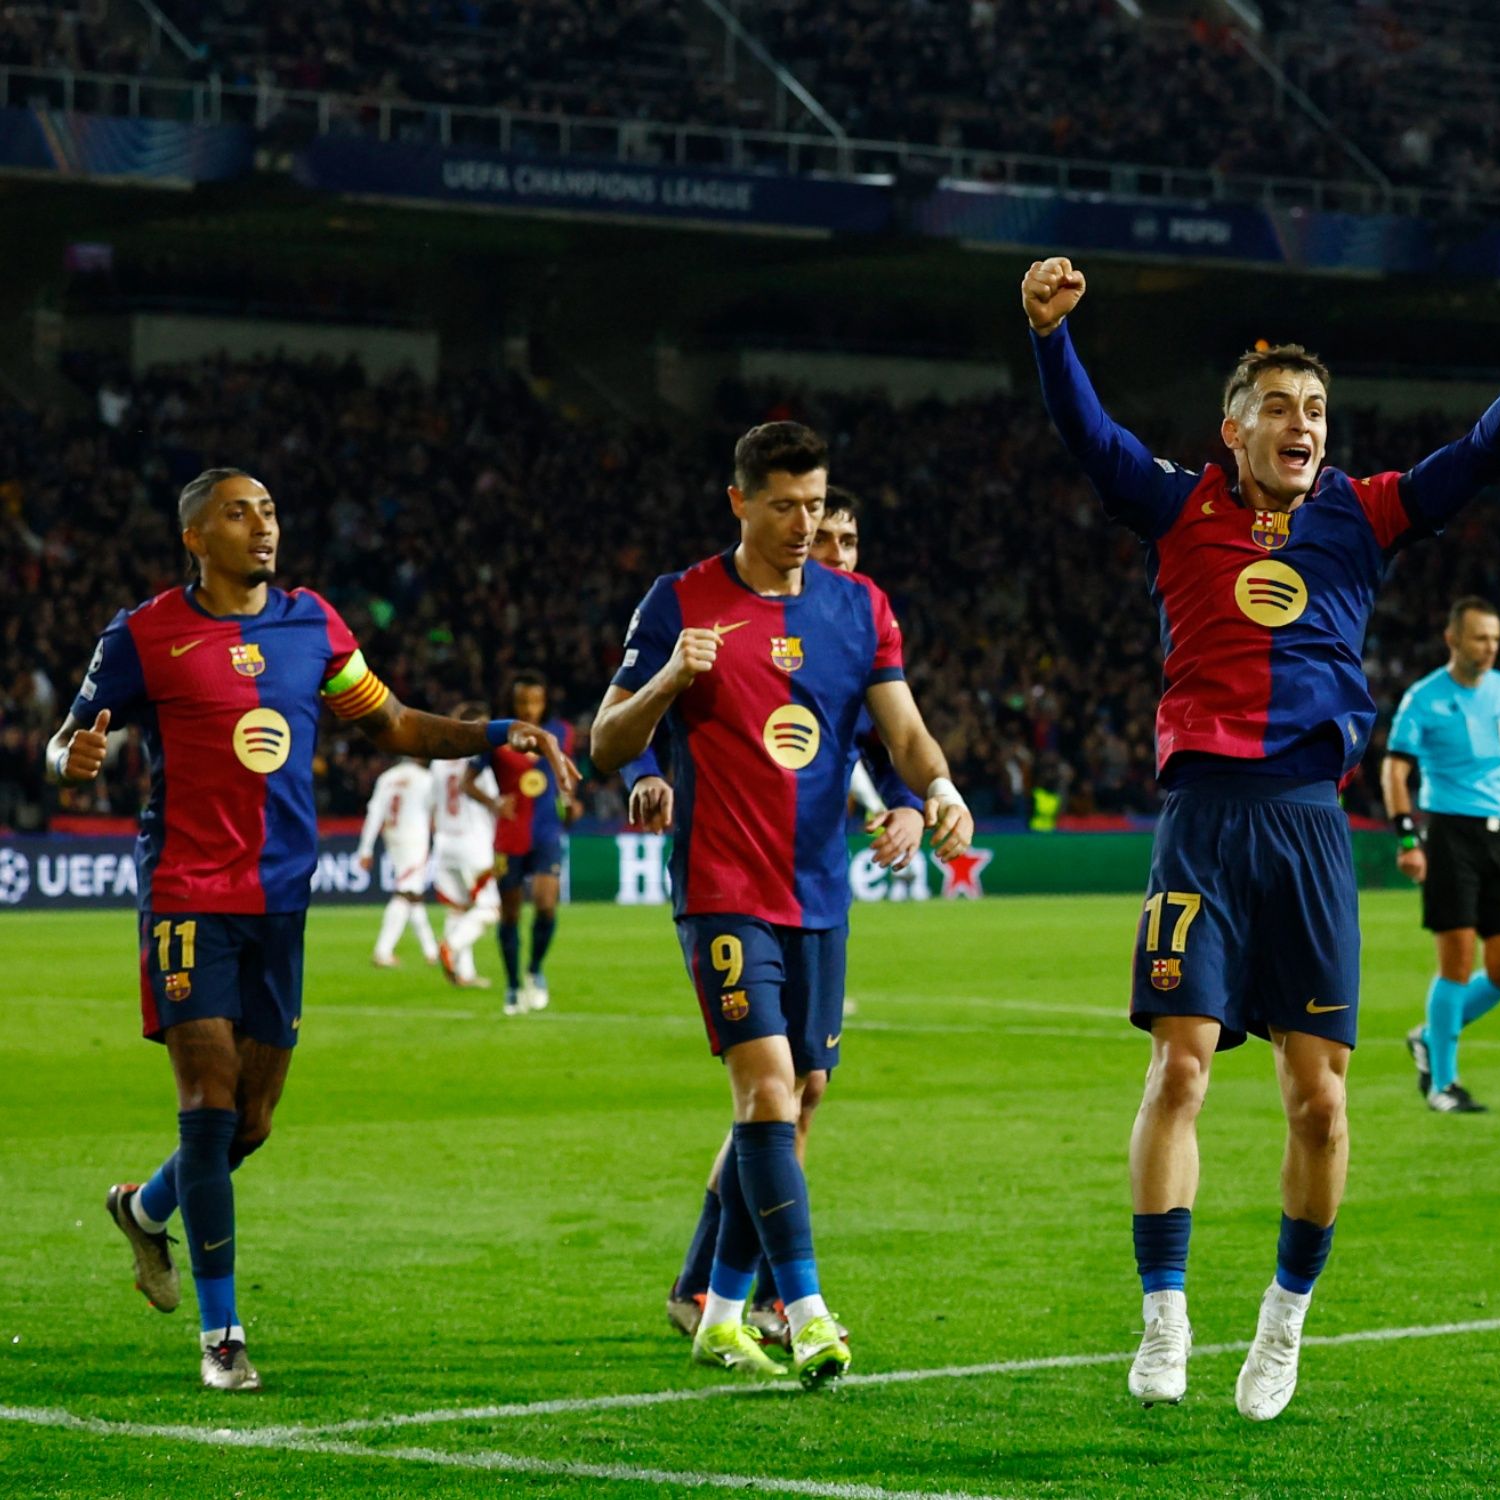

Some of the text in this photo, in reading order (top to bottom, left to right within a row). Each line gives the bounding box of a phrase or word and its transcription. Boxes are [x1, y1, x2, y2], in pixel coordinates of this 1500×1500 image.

[443, 160, 750, 211] UEFA CHAMPIONS LEAGUE
[37, 853, 138, 897] UEFA
[153, 920, 197, 971] 11
[1144, 891, 1201, 953] 17
[710, 934, 744, 987] 9
